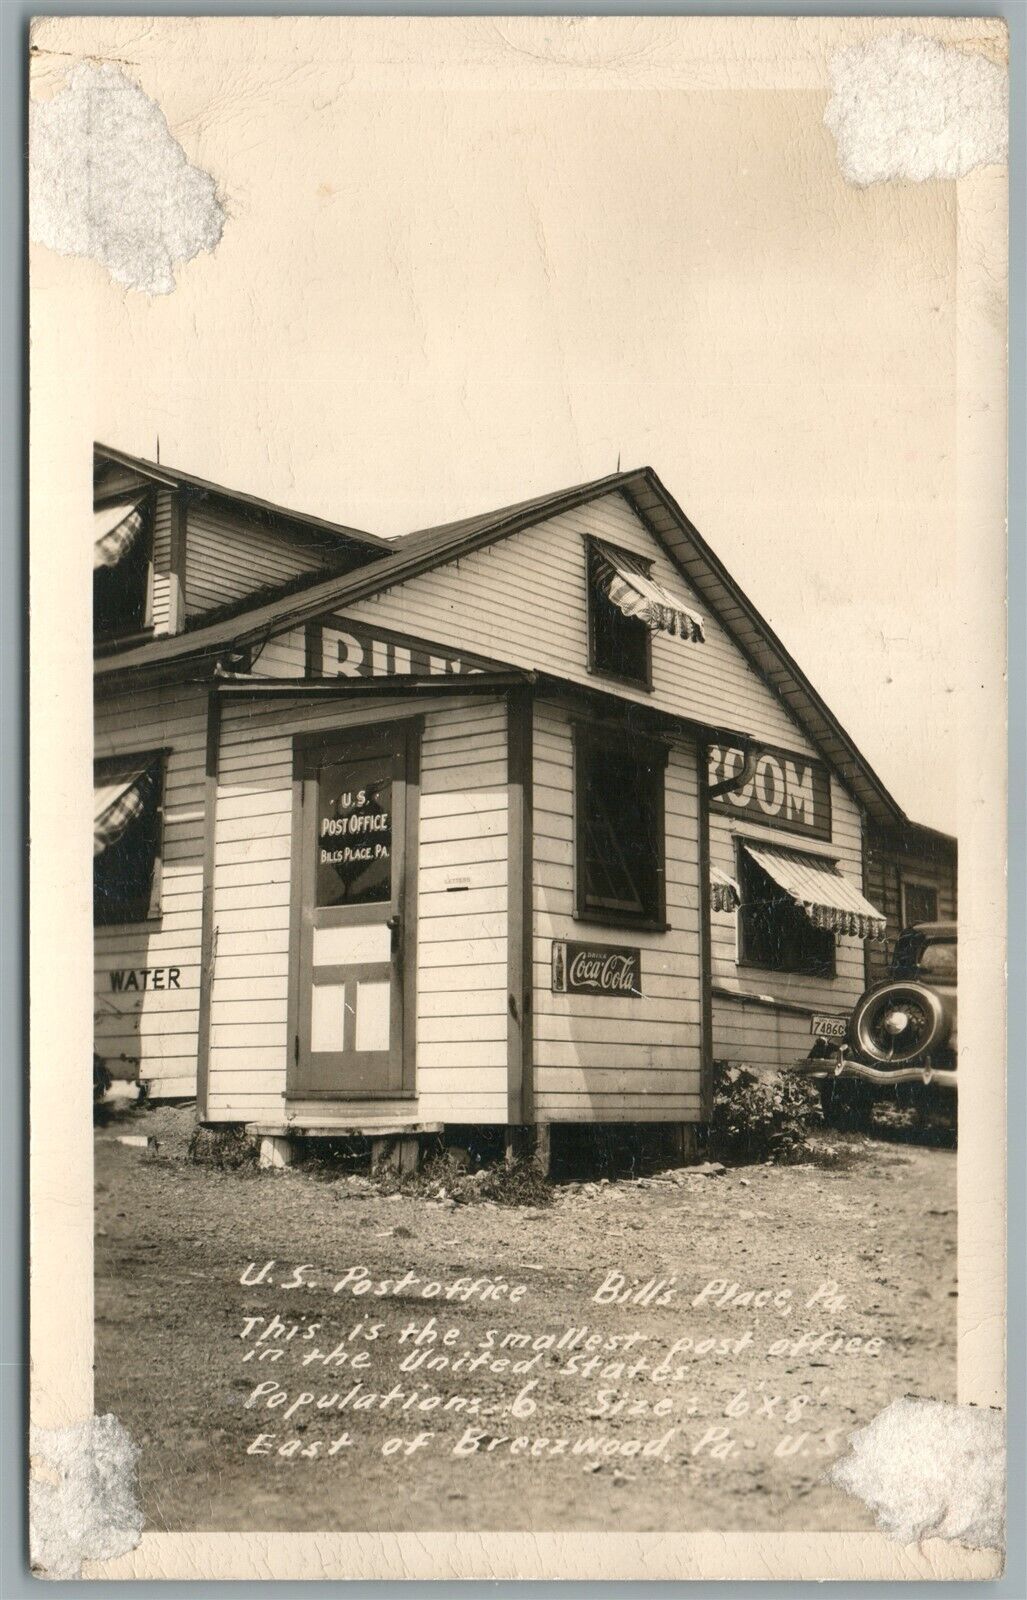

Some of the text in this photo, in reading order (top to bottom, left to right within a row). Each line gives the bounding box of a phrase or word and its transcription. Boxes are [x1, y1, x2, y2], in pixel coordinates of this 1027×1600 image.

[321, 813, 388, 837] POST OFFICE
[109, 968, 181, 993] WATER
[569, 951, 635, 989] Coca-Cola
